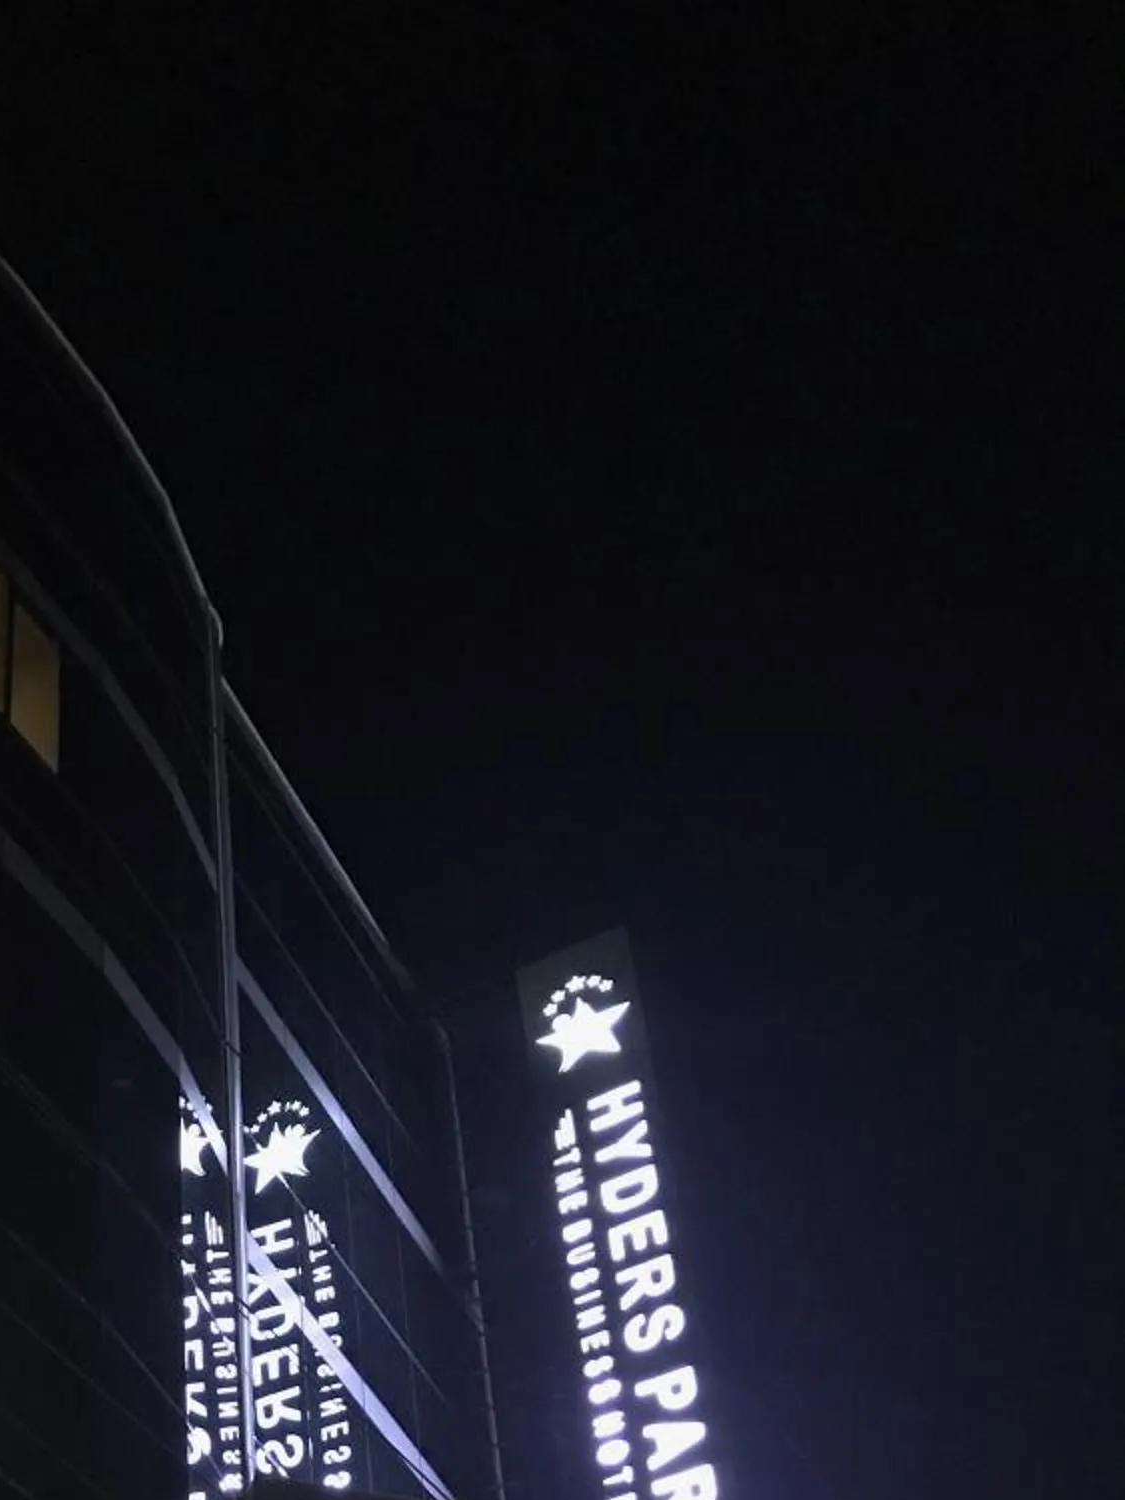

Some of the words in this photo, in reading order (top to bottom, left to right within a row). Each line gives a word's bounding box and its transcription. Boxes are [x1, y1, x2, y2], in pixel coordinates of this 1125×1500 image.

[552, 1146, 589, 1215] THE
[586, 1079, 686, 1353] HYDERS
[561, 1217, 623, 1405] BUSINESS
